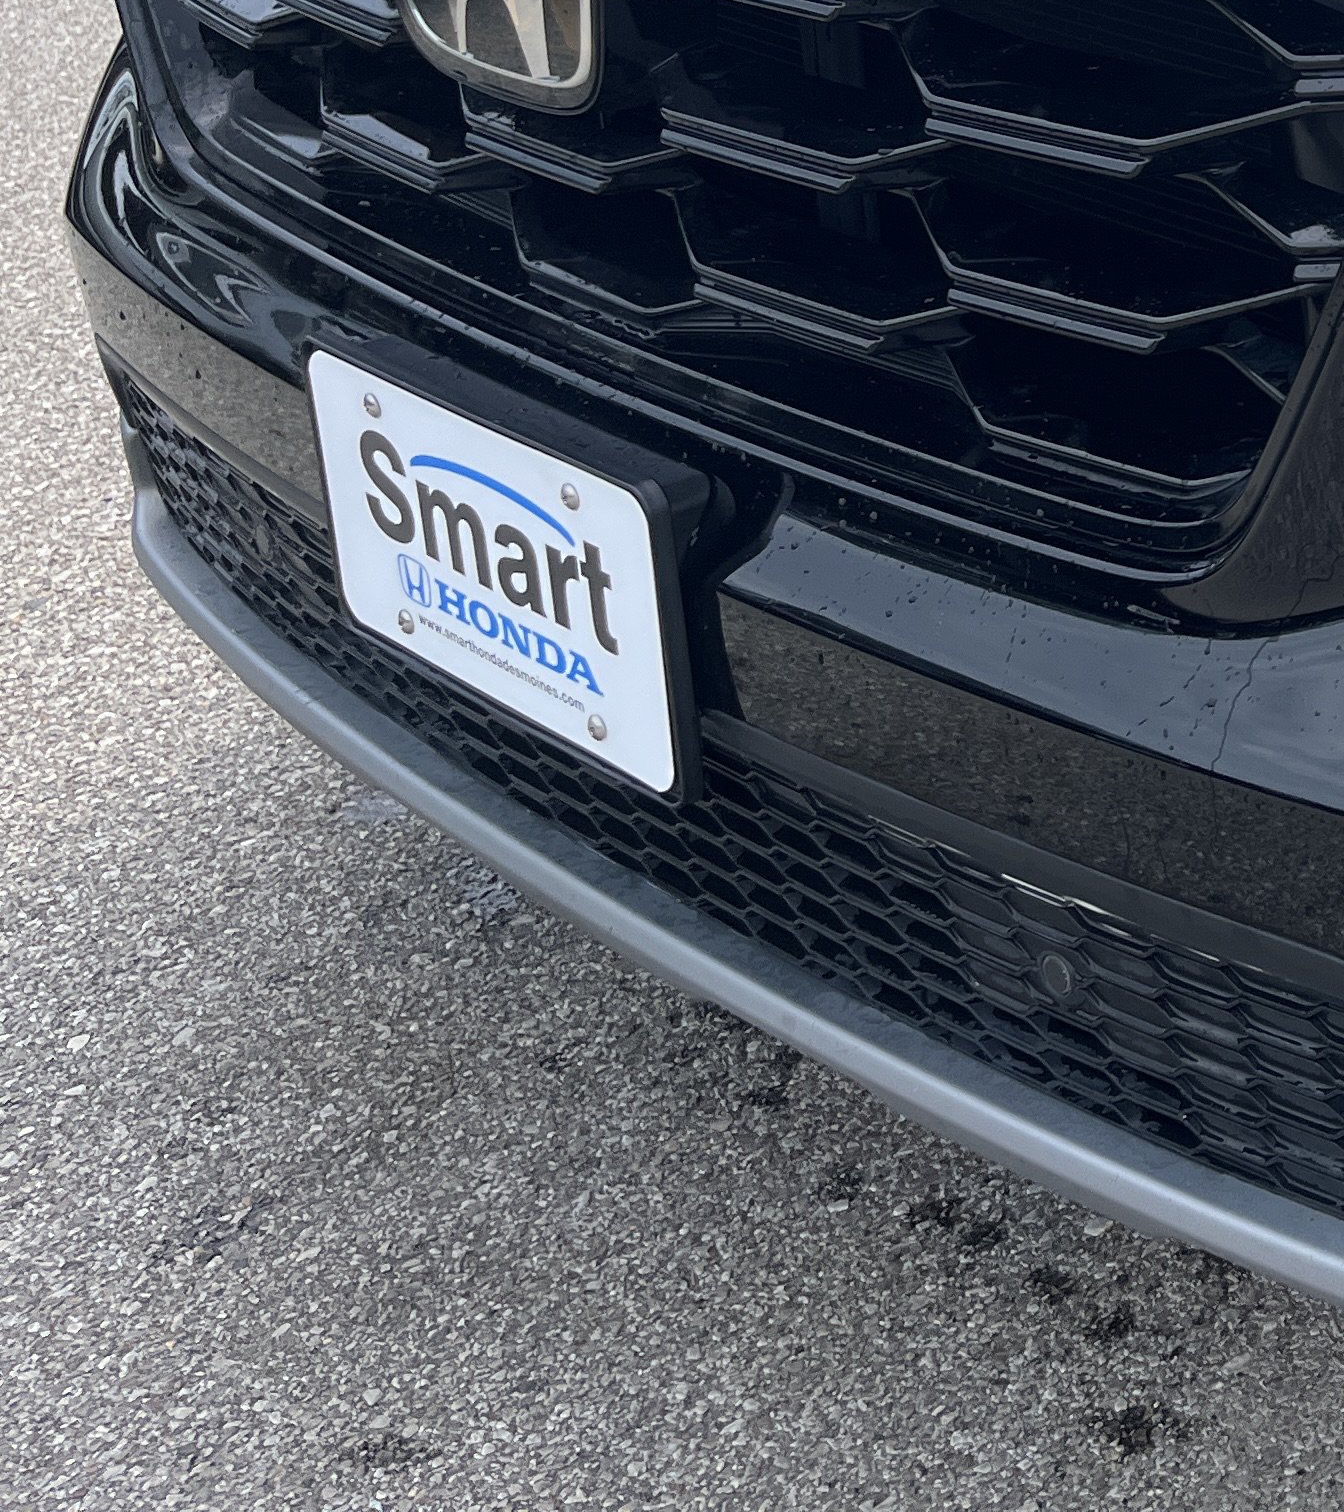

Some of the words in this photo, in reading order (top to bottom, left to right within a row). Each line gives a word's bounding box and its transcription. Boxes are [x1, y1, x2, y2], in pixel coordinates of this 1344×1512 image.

[359, 429, 619, 656] Smart
[418, 613, 586, 713] www.smarthondadesmoines.com
[434, 577, 604, 697] HONDA
